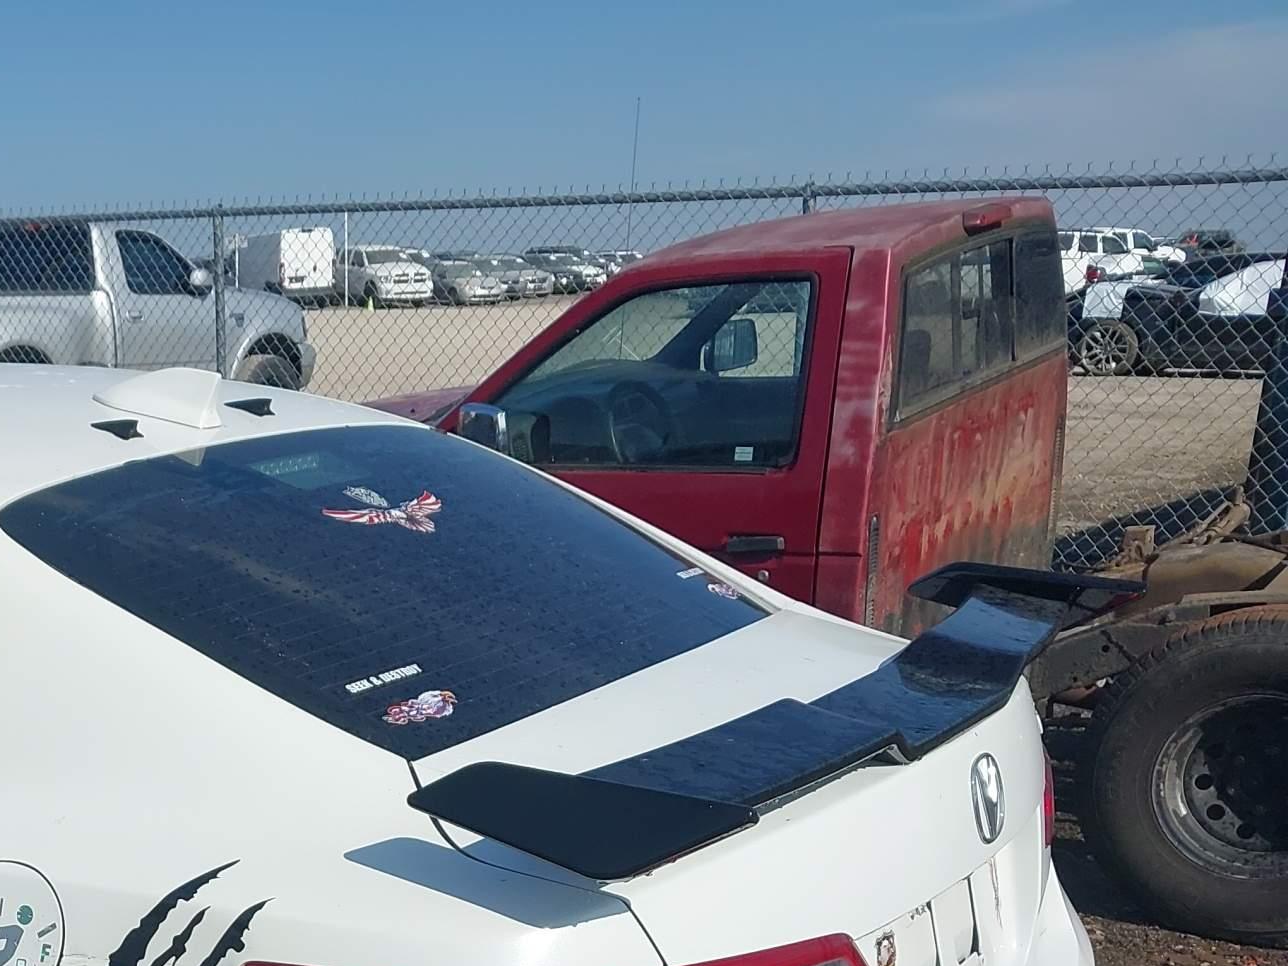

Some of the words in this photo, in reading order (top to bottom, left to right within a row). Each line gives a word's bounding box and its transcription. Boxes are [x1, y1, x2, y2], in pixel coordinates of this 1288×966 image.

[345, 679, 374, 693] SEEK
[369, 676, 384, 686] &
[378, 663, 423, 683] DESTROY
[40, 943, 52, 963] F
